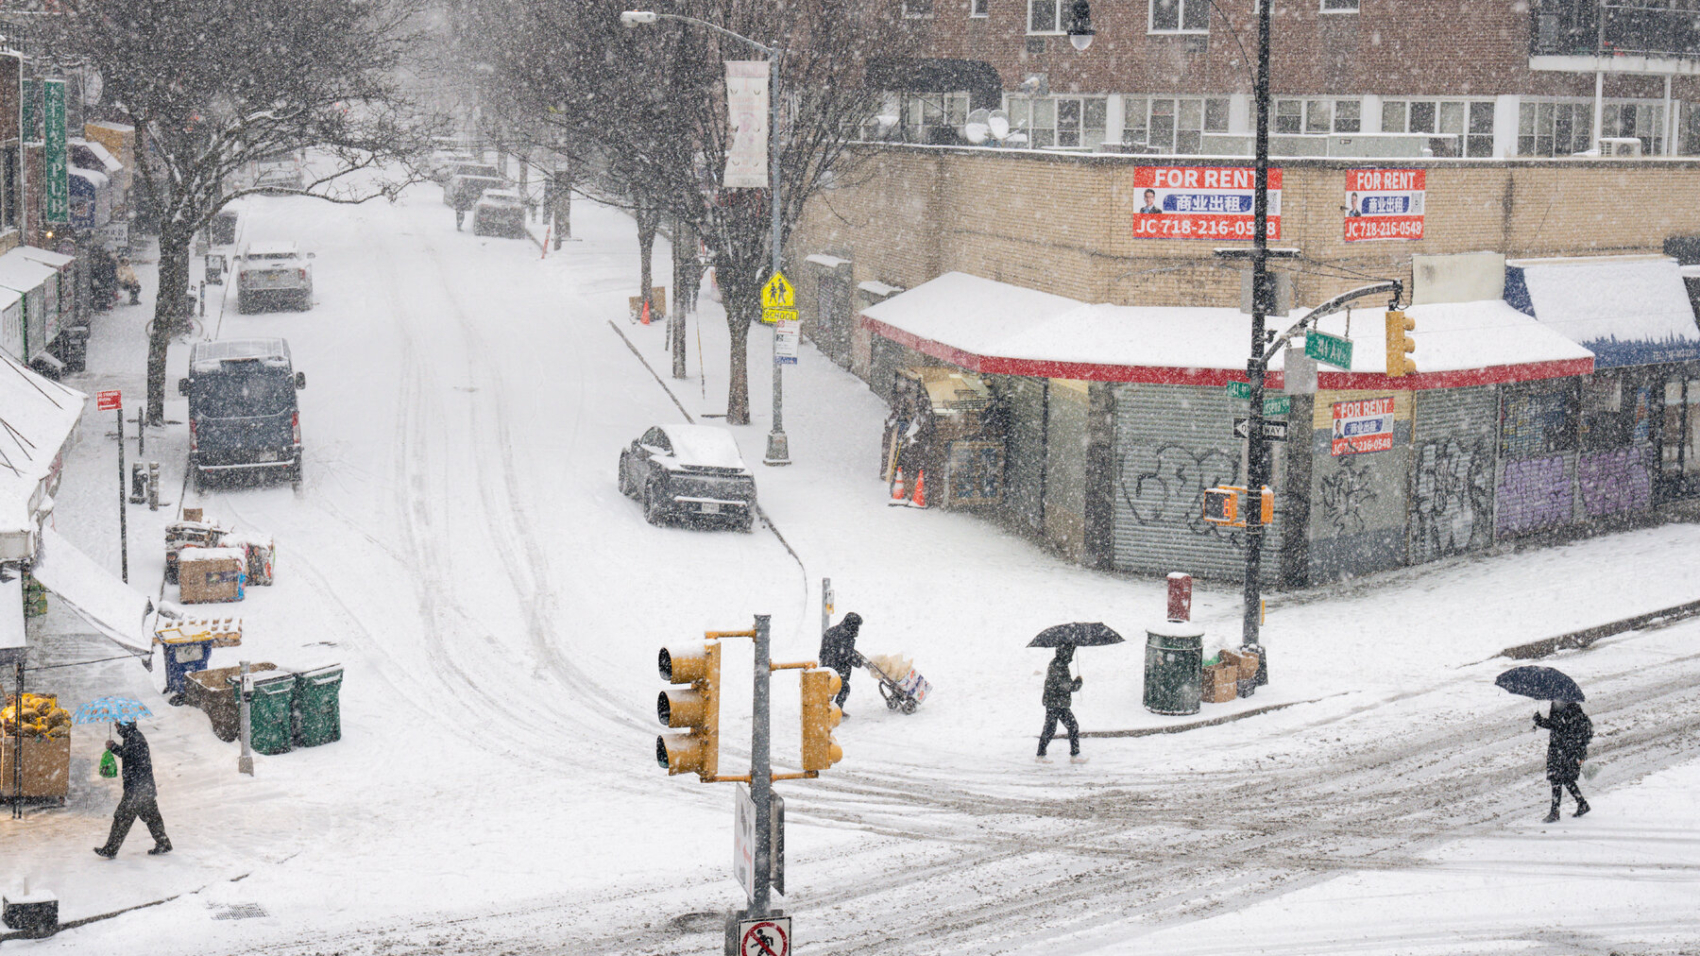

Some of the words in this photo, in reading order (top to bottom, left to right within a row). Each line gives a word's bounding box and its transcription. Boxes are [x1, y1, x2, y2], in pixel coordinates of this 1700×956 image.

[1154, 169, 1198, 187] FOR
[1357, 172, 1381, 189] FOR
[1384, 172, 1416, 189] RENT
[52, 163, 63, 213] PUB
[1176, 194, 1241, 212] 商业出租
[1136, 219, 1157, 233] JC
[1160, 219, 1276, 235] 718-216-058
[1346, 222, 1358, 237] JC
[1360, 221, 1422, 236] 718-216-0548
[764, 310, 796, 320] SCHOOL
[1341, 402, 1361, 418] FOR
[1363, 399, 1390, 416] RENT
[1332, 443, 1343, 455] JC
